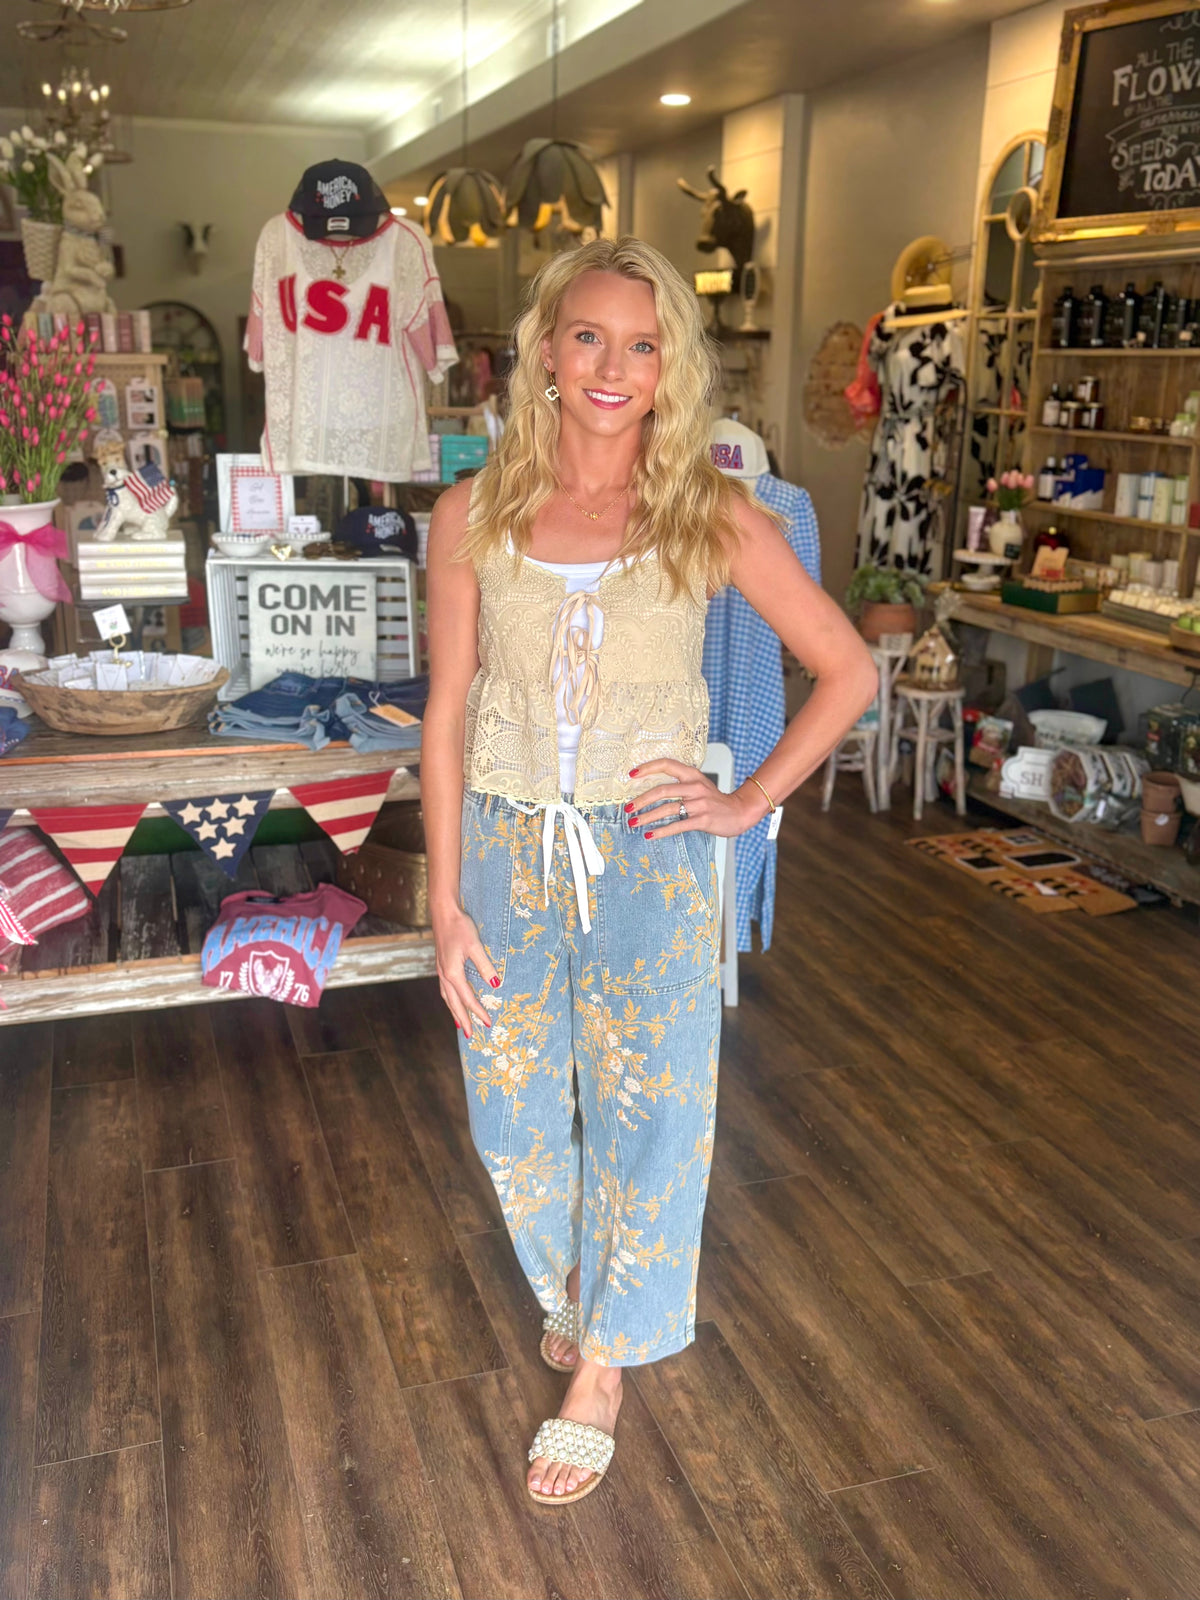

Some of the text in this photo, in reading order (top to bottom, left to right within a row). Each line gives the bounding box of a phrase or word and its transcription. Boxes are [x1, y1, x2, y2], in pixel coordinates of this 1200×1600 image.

[1112, 59, 1200, 106] FLOW
[1111, 135, 1179, 171] SEEDS
[278, 273, 391, 347] USA
[258, 583, 367, 612] COME
[271, 614, 355, 637] ON IN
[319, 640, 361, 666] happy
[201, 914, 343, 990] AMERICA
[293, 983, 310, 1003] 76
